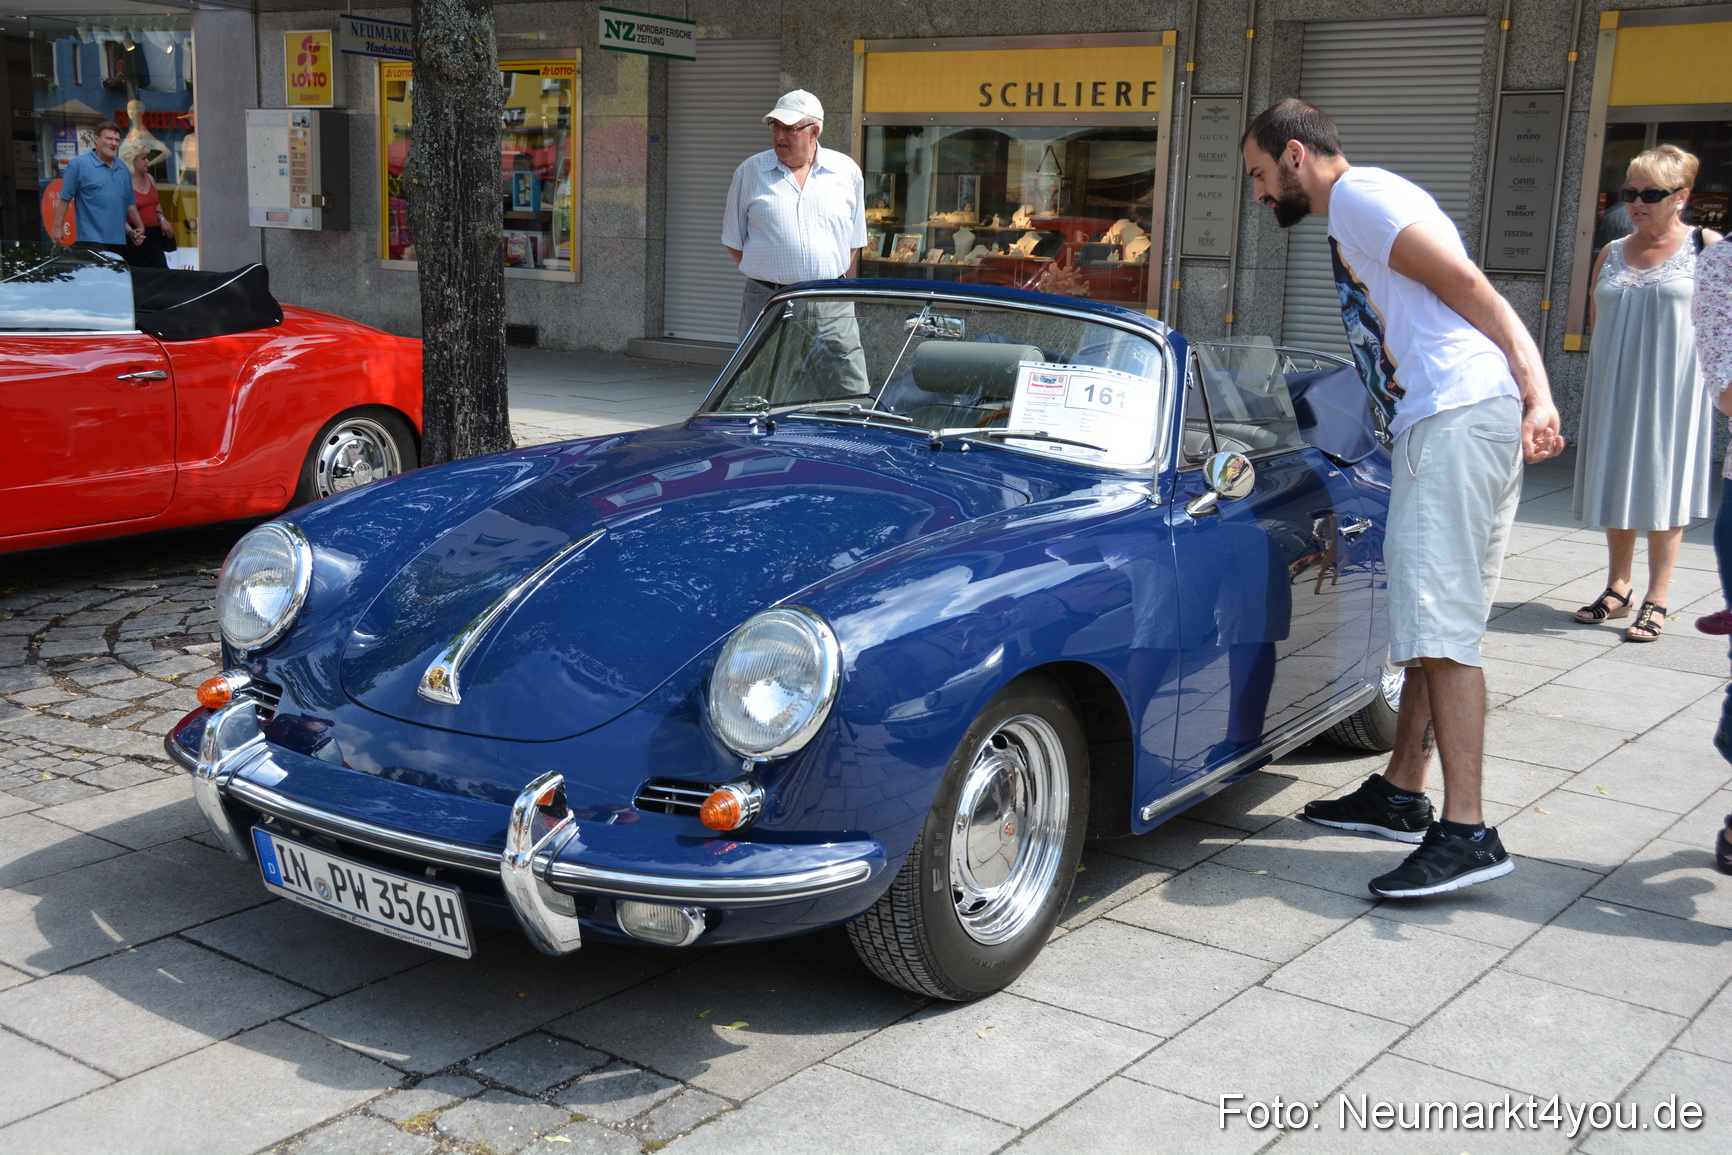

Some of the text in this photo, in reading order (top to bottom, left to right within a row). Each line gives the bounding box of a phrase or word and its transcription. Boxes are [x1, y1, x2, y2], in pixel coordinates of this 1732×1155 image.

[603, 18, 636, 42] NZ
[636, 23, 692, 40] NORDBAYERISCHE
[636, 34, 665, 46] ZEITUNG
[550, 66, 573, 76] LOTTO
[291, 71, 328, 88] LOTTO
[300, 92, 320, 102] Bayern
[978, 81, 1157, 107] SCHLIERF
[1512, 177, 1535, 186] ORIS
[1197, 191, 1223, 199] ALFEX
[1504, 230, 1533, 238] FESTINA
[1502, 246, 1531, 255] ESPRIT
[1084, 383, 1126, 409] 161
[267, 862, 276, 875] D
[276, 843, 462, 940] IN PW 356H
[383, 927, 432, 947] Siegerland
